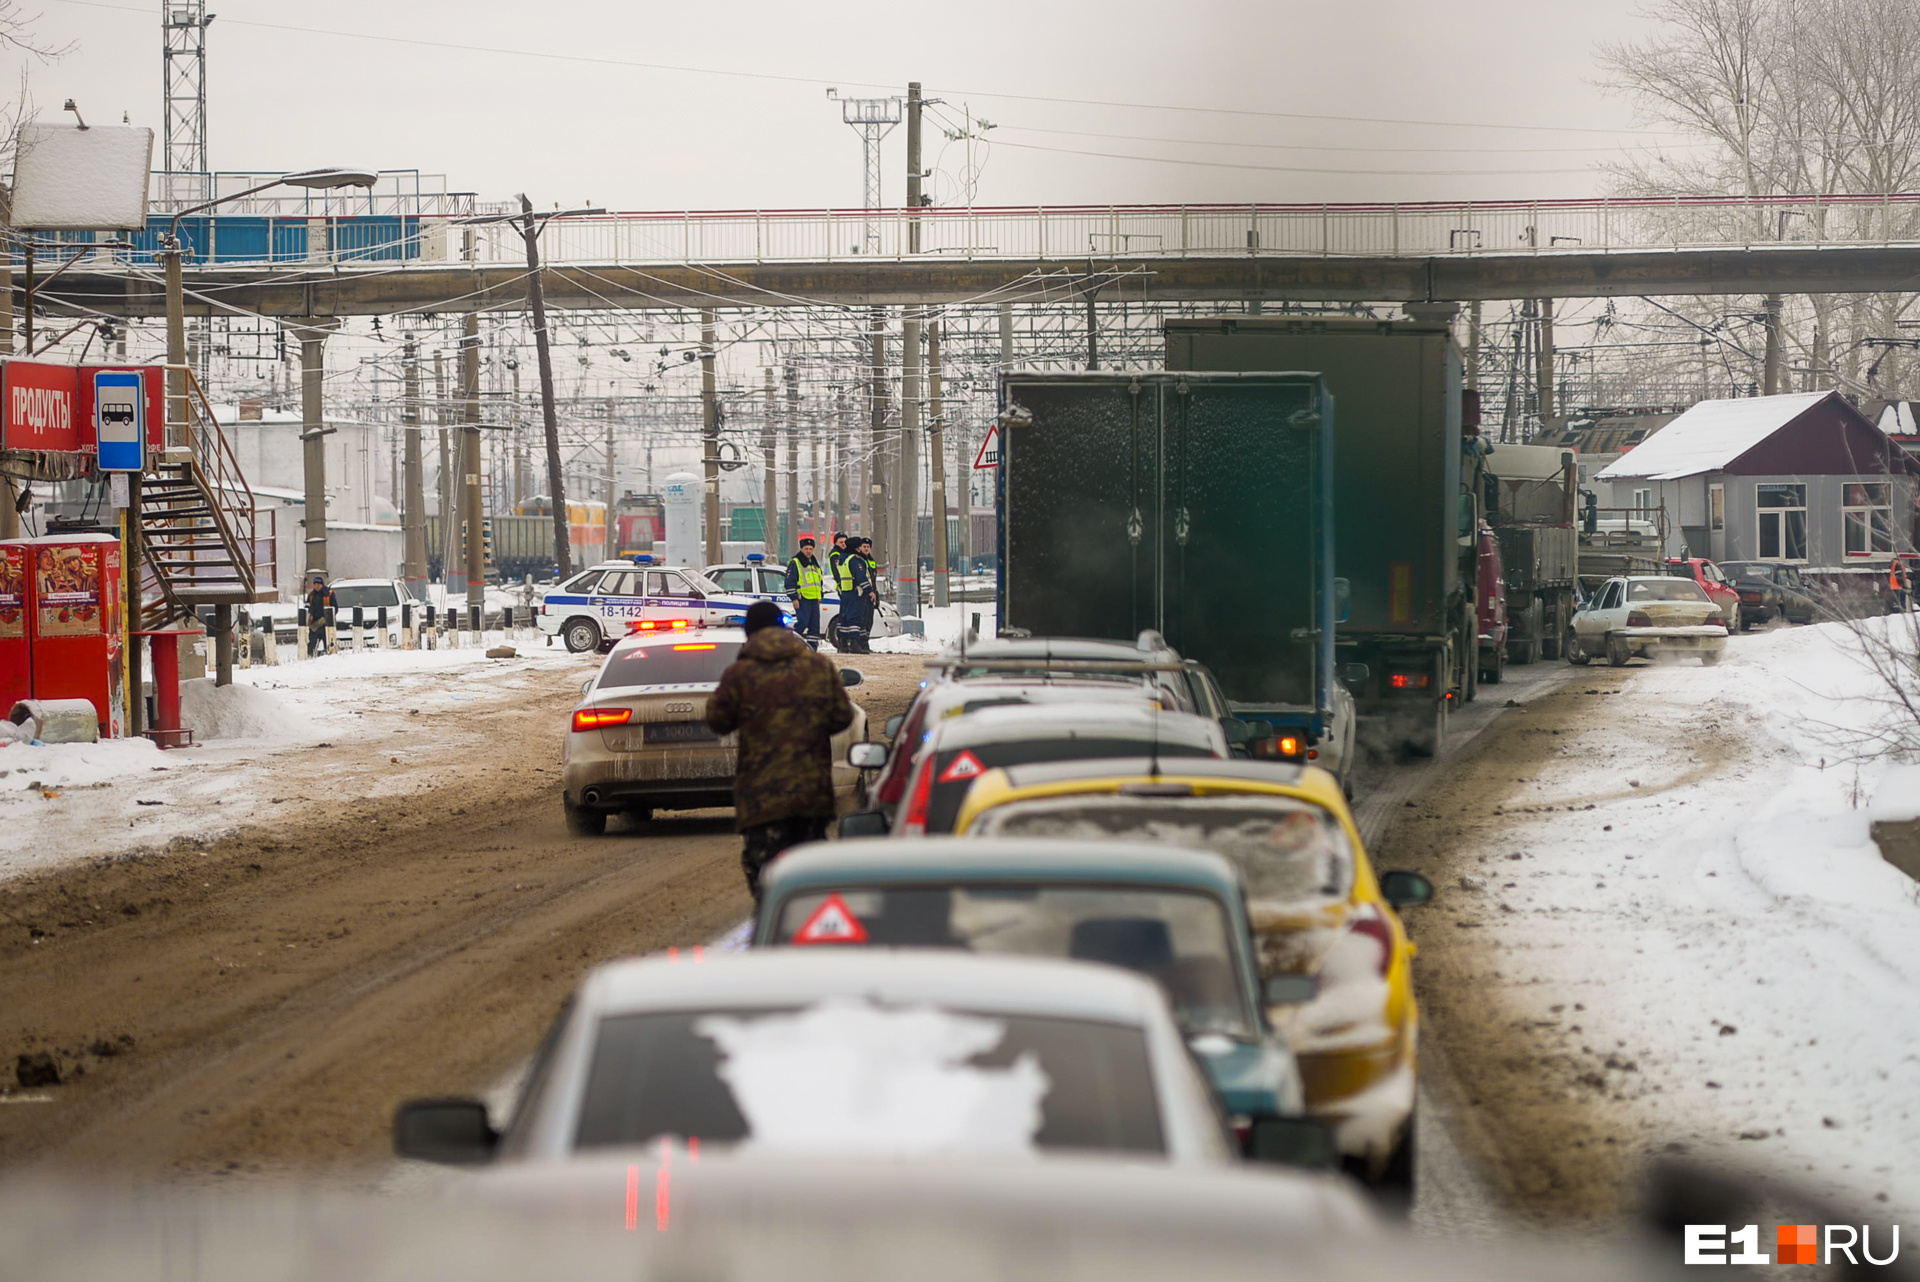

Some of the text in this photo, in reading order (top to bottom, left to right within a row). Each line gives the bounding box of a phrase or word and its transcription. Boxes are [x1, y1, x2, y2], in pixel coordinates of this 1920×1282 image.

[12, 386, 71, 434] ПРОДУКТЫ
[80, 443, 161, 452] ХОТ- ОФЕ
[600, 606, 642, 617] 18-142
